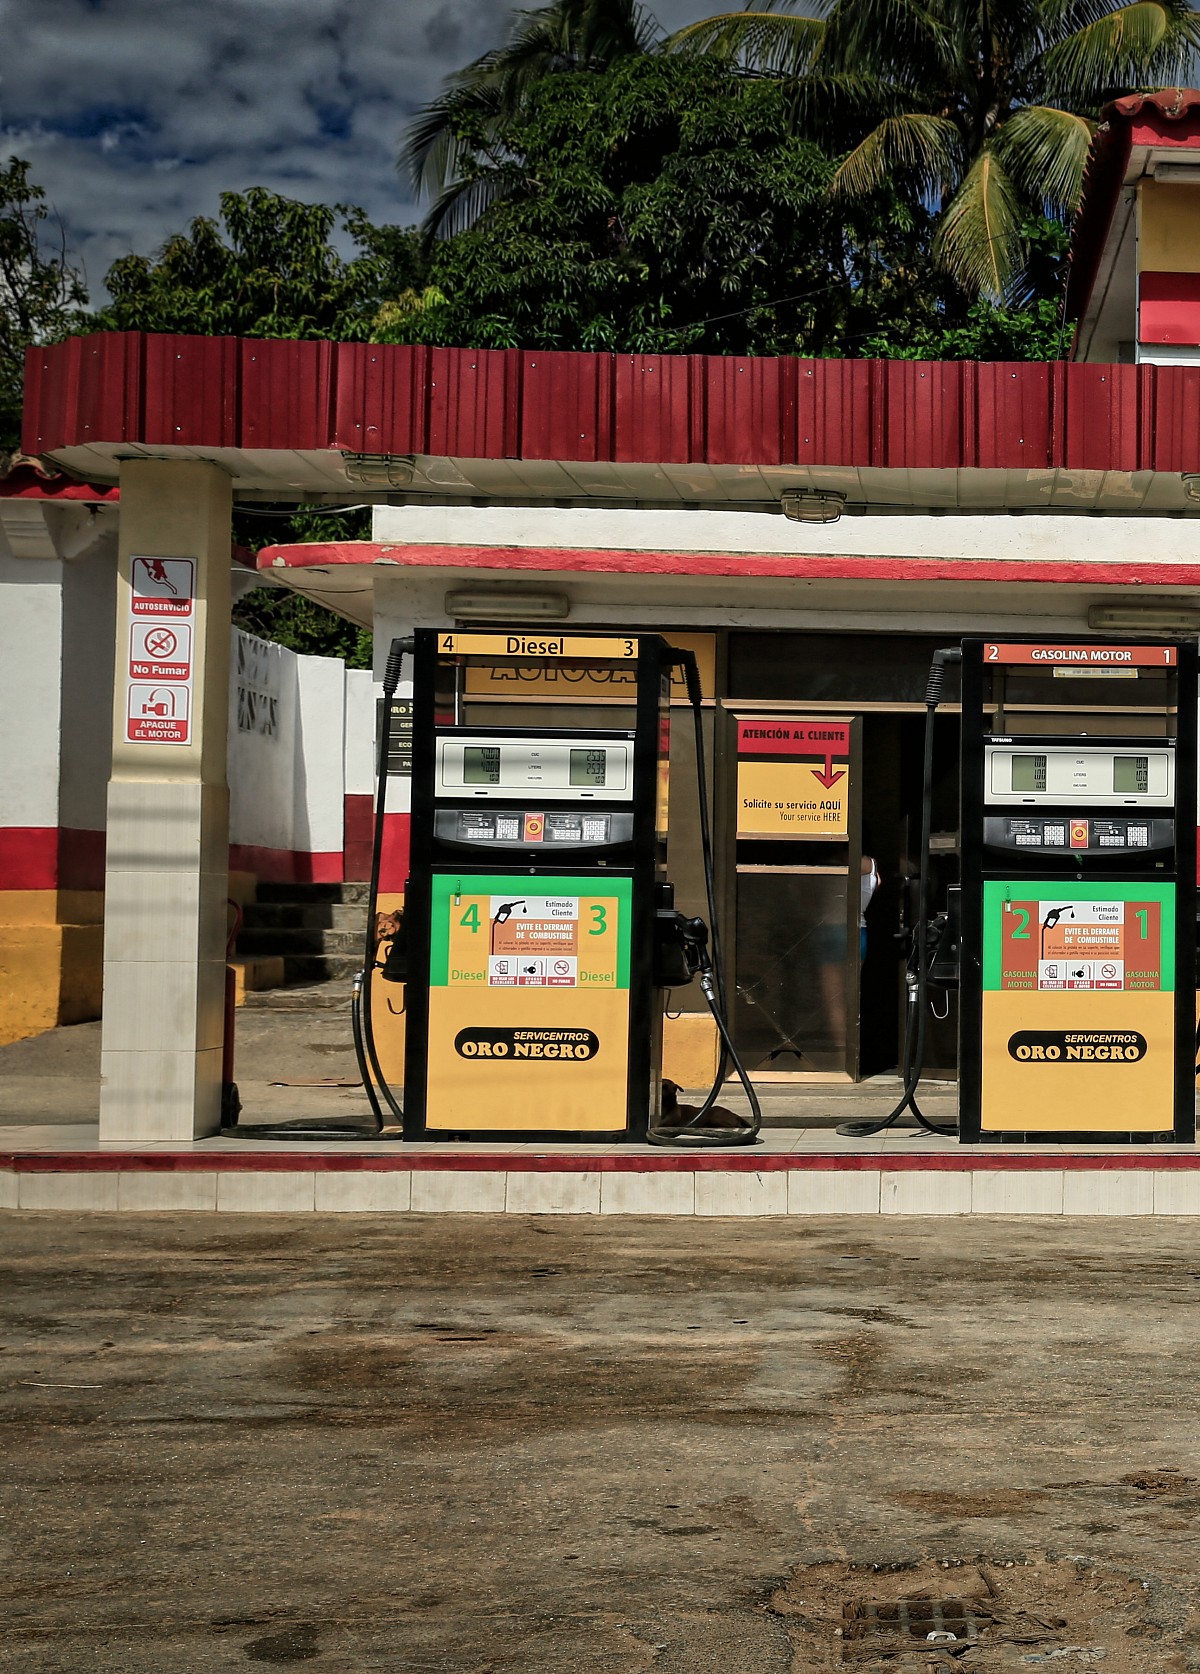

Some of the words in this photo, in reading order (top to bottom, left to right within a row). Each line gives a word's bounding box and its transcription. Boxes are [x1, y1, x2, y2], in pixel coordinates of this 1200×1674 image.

[134, 602, 190, 612] AUTOSERVICIO
[442, 636, 454, 652] 4
[507, 637, 563, 655] Diesel
[624, 640, 634, 657] 3
[988, 645, 999, 660] 2
[1032, 650, 1088, 661] GASOLINA
[1091, 650, 1132, 661] MOTOR
[1163, 649, 1171, 664] 1
[133, 665, 149, 675] No
[152, 666, 187, 676] Fumar
[140, 721, 177, 730] APAGUE
[135, 730, 147, 738] EL
[149, 730, 181, 739] MOTOR
[743, 728, 789, 739] ATENCIÓN
[793, 730, 804, 739] AL
[808, 731, 844, 740] CLIENTE
[744, 799, 772, 809] Solicite
[787, 801, 817, 810] servicio
[780, 812, 795, 821] Your
[797, 812, 821, 821] service
[823, 813, 841, 822] HERE
[460, 904, 481, 933] 4
[588, 905, 607, 935] 3
[1012, 909, 1030, 939] 2
[1135, 910, 1148, 940] 1
[529, 932, 573, 940] COMBUSTIBLE
[451, 970, 486, 980] Diesel
[580, 971, 614, 981] Diesel
[514, 1032, 589, 1040] SERVICENTROS
[1064, 1035, 1137, 1043] SERVICENTROS
[462, 1042, 508, 1056] ORO
[514, 1043, 590, 1058] NEGRO
[1016, 1045, 1060, 1059] ORO
[1066, 1045, 1139, 1060] NEGRO
